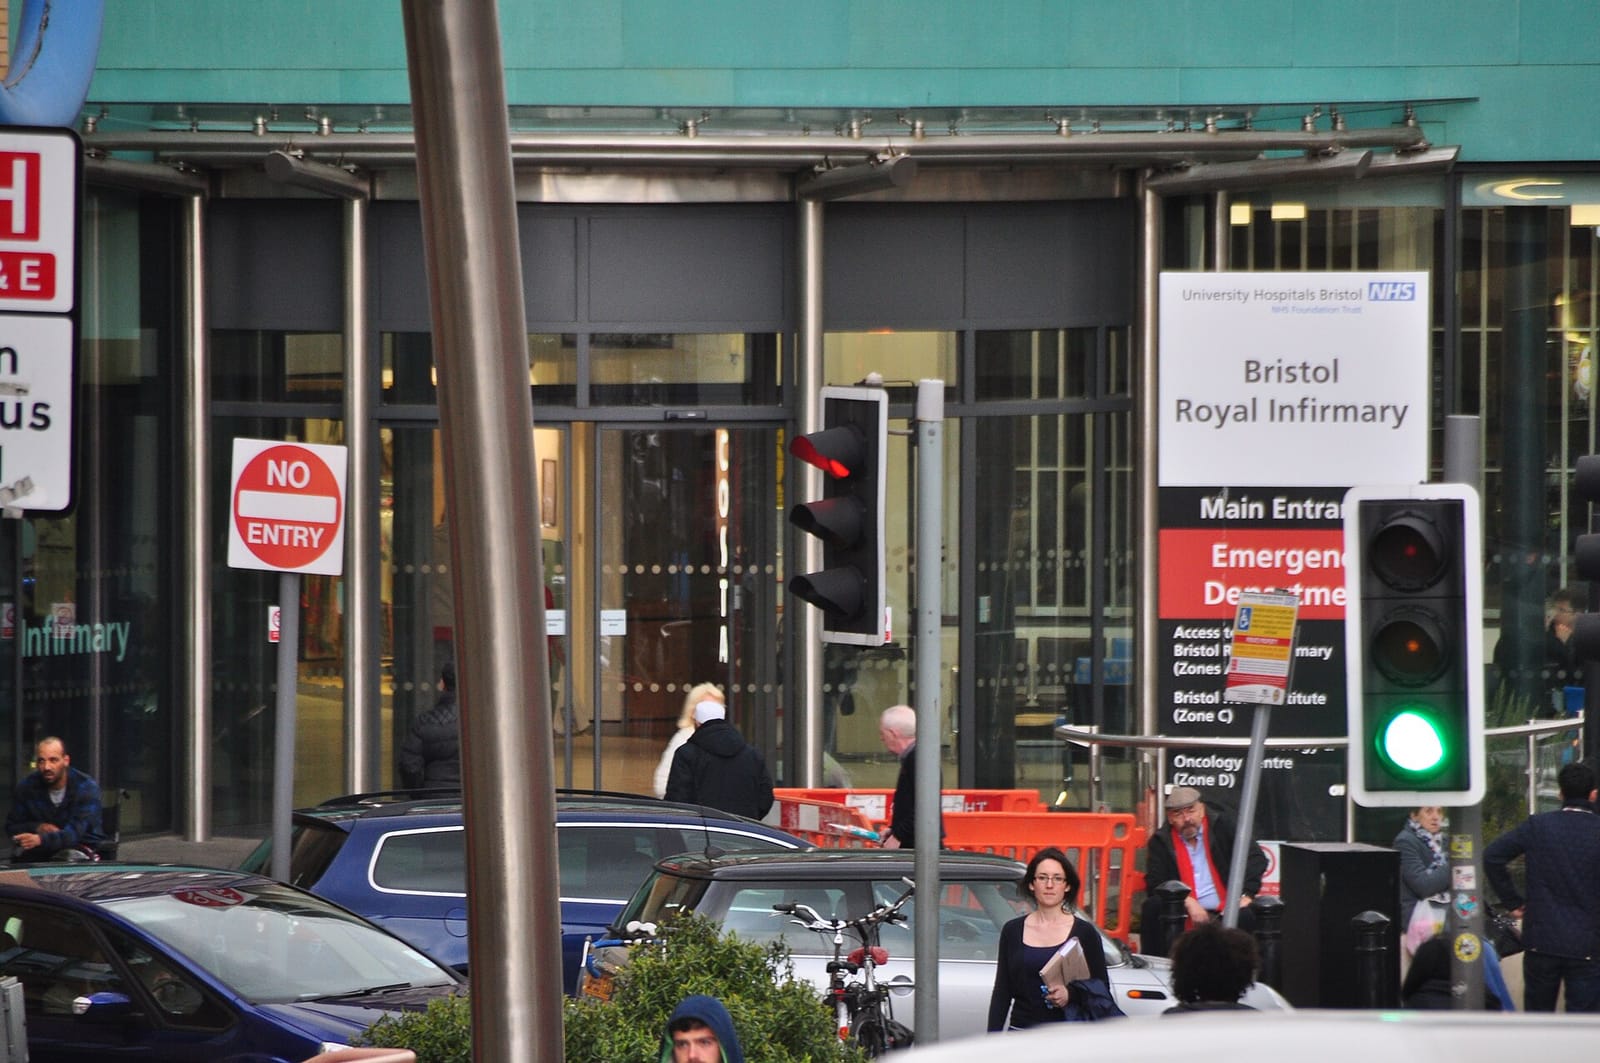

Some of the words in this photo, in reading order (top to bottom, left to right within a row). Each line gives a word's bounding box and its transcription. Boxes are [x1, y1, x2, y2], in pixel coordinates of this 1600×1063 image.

[1182, 289, 1249, 303] University
[1254, 289, 1315, 303] Hospitals
[1320, 288, 1363, 301] Bristol
[1369, 283, 1414, 300] NHS
[1291, 306, 1340, 314] Foundation
[1244, 358, 1339, 383] Bristol
[1175, 398, 1257, 429] Royal
[1269, 397, 1409, 430] Infirmary
[267, 459, 311, 489] NO
[1200, 497, 1264, 520] Main
[1272, 498, 1344, 520] Entra
[248, 522, 325, 548] ENTRY
[1211, 543, 1345, 575] Emergen
[21, 614, 131, 662] Infirmary
[1173, 626, 1220, 640] Access
[1173, 643, 1219, 657] Bristol
[1173, 661, 1221, 676] (Zones
[1173, 691, 1219, 705] Bristol
[1173, 709, 1214, 724] (Zone
[1217, 709, 1234, 724] C)
[1174, 754, 1243, 771] Oncology
[1174, 773, 1215, 788] (Zone
[1218, 773, 1235, 788] D)
